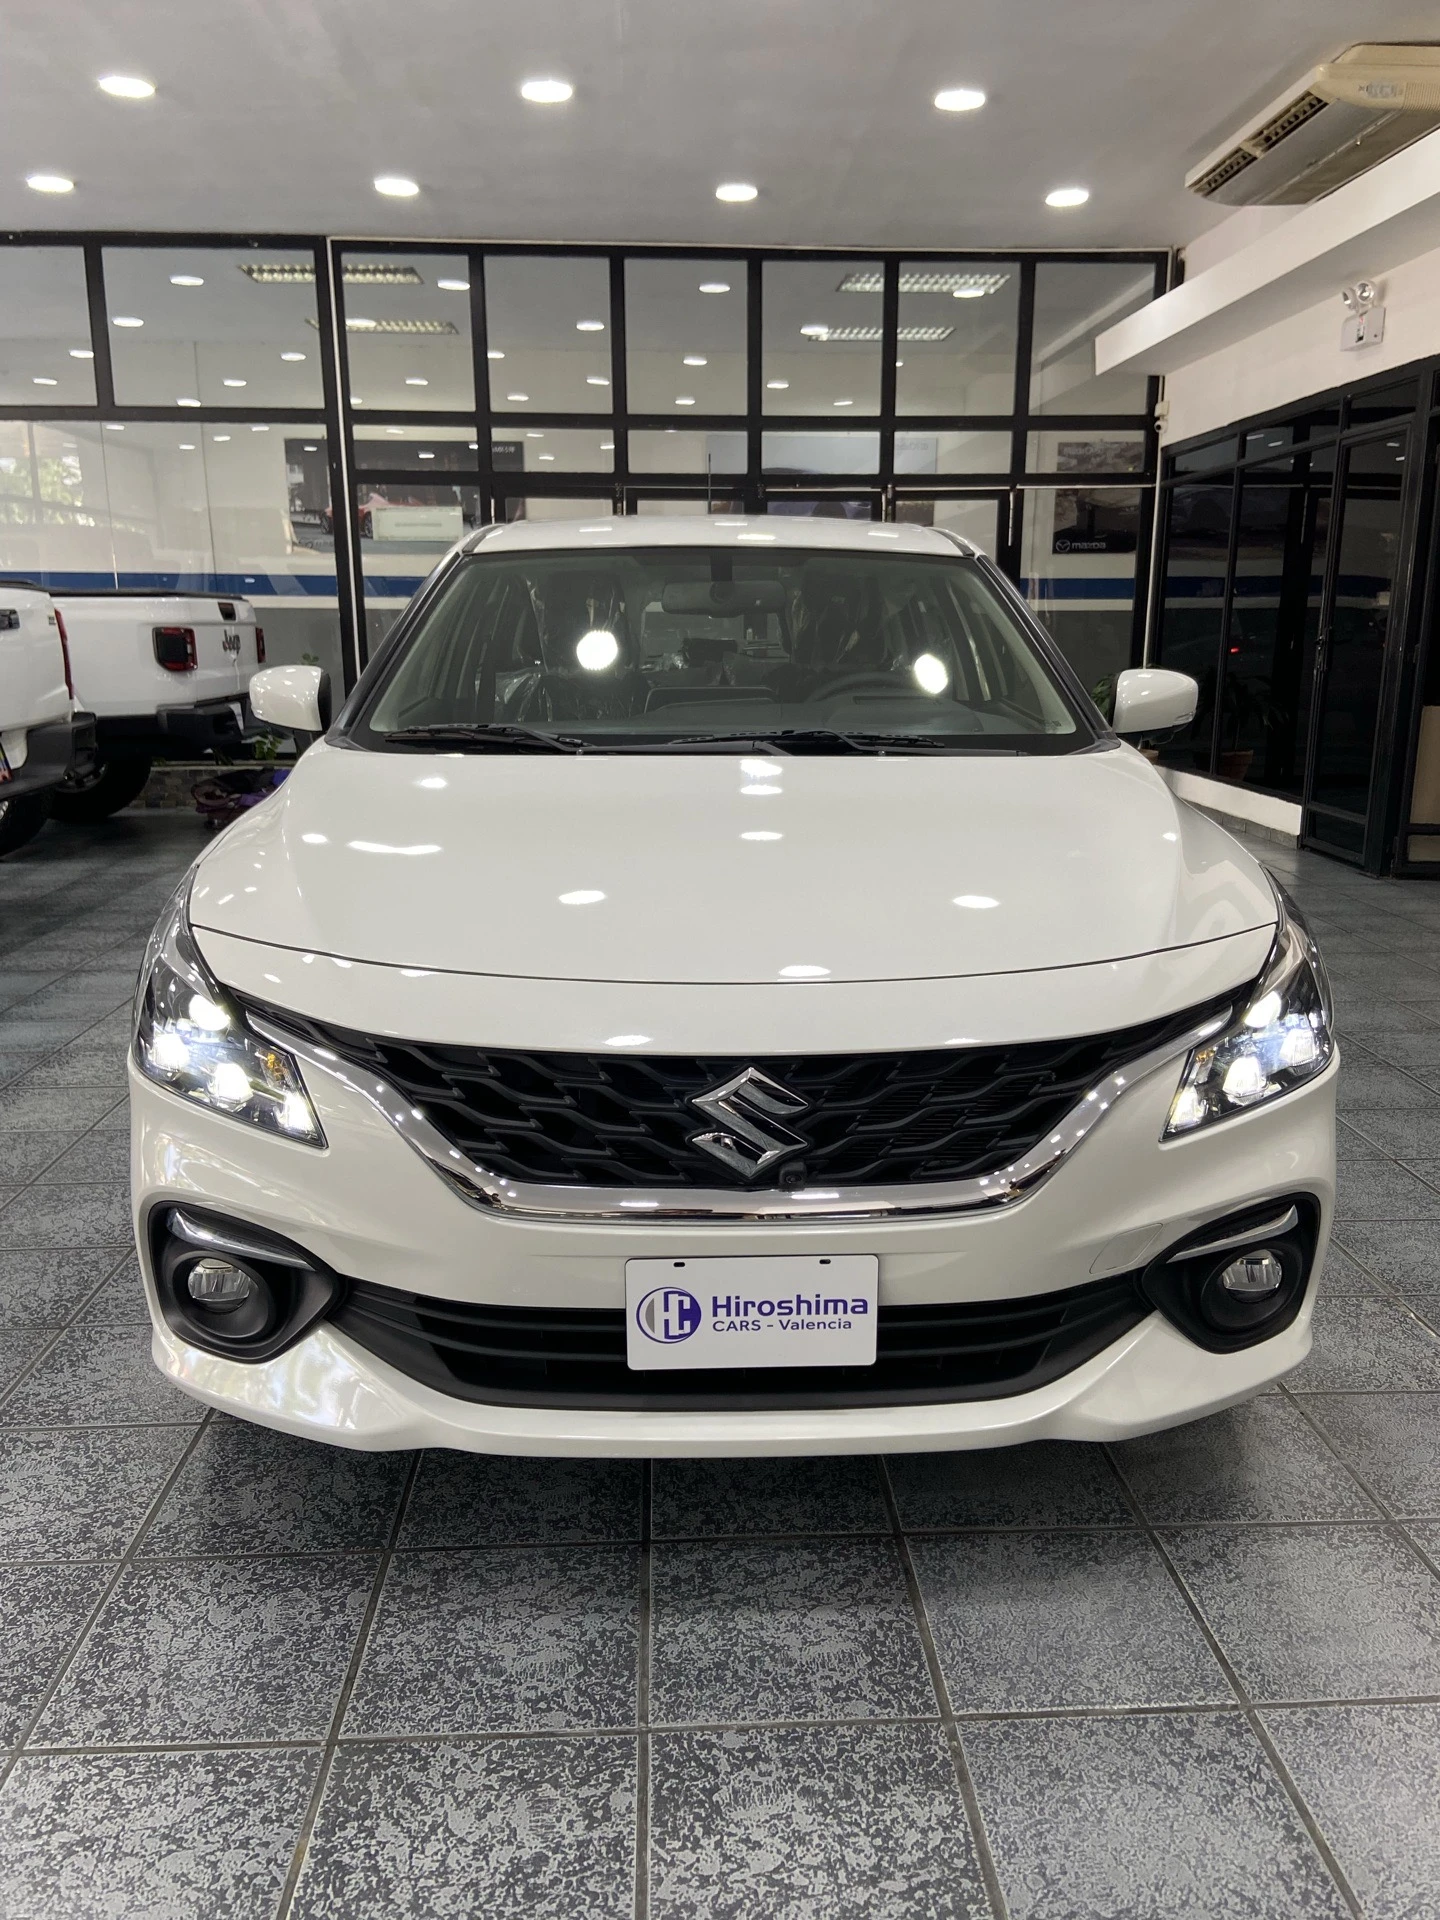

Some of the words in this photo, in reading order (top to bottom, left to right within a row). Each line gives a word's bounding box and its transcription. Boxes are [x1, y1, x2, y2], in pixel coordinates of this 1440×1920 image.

[711, 1293, 869, 1318] Hiroshima
[712, 1319, 762, 1332] CARS
[778, 1317, 852, 1331] Valencia
